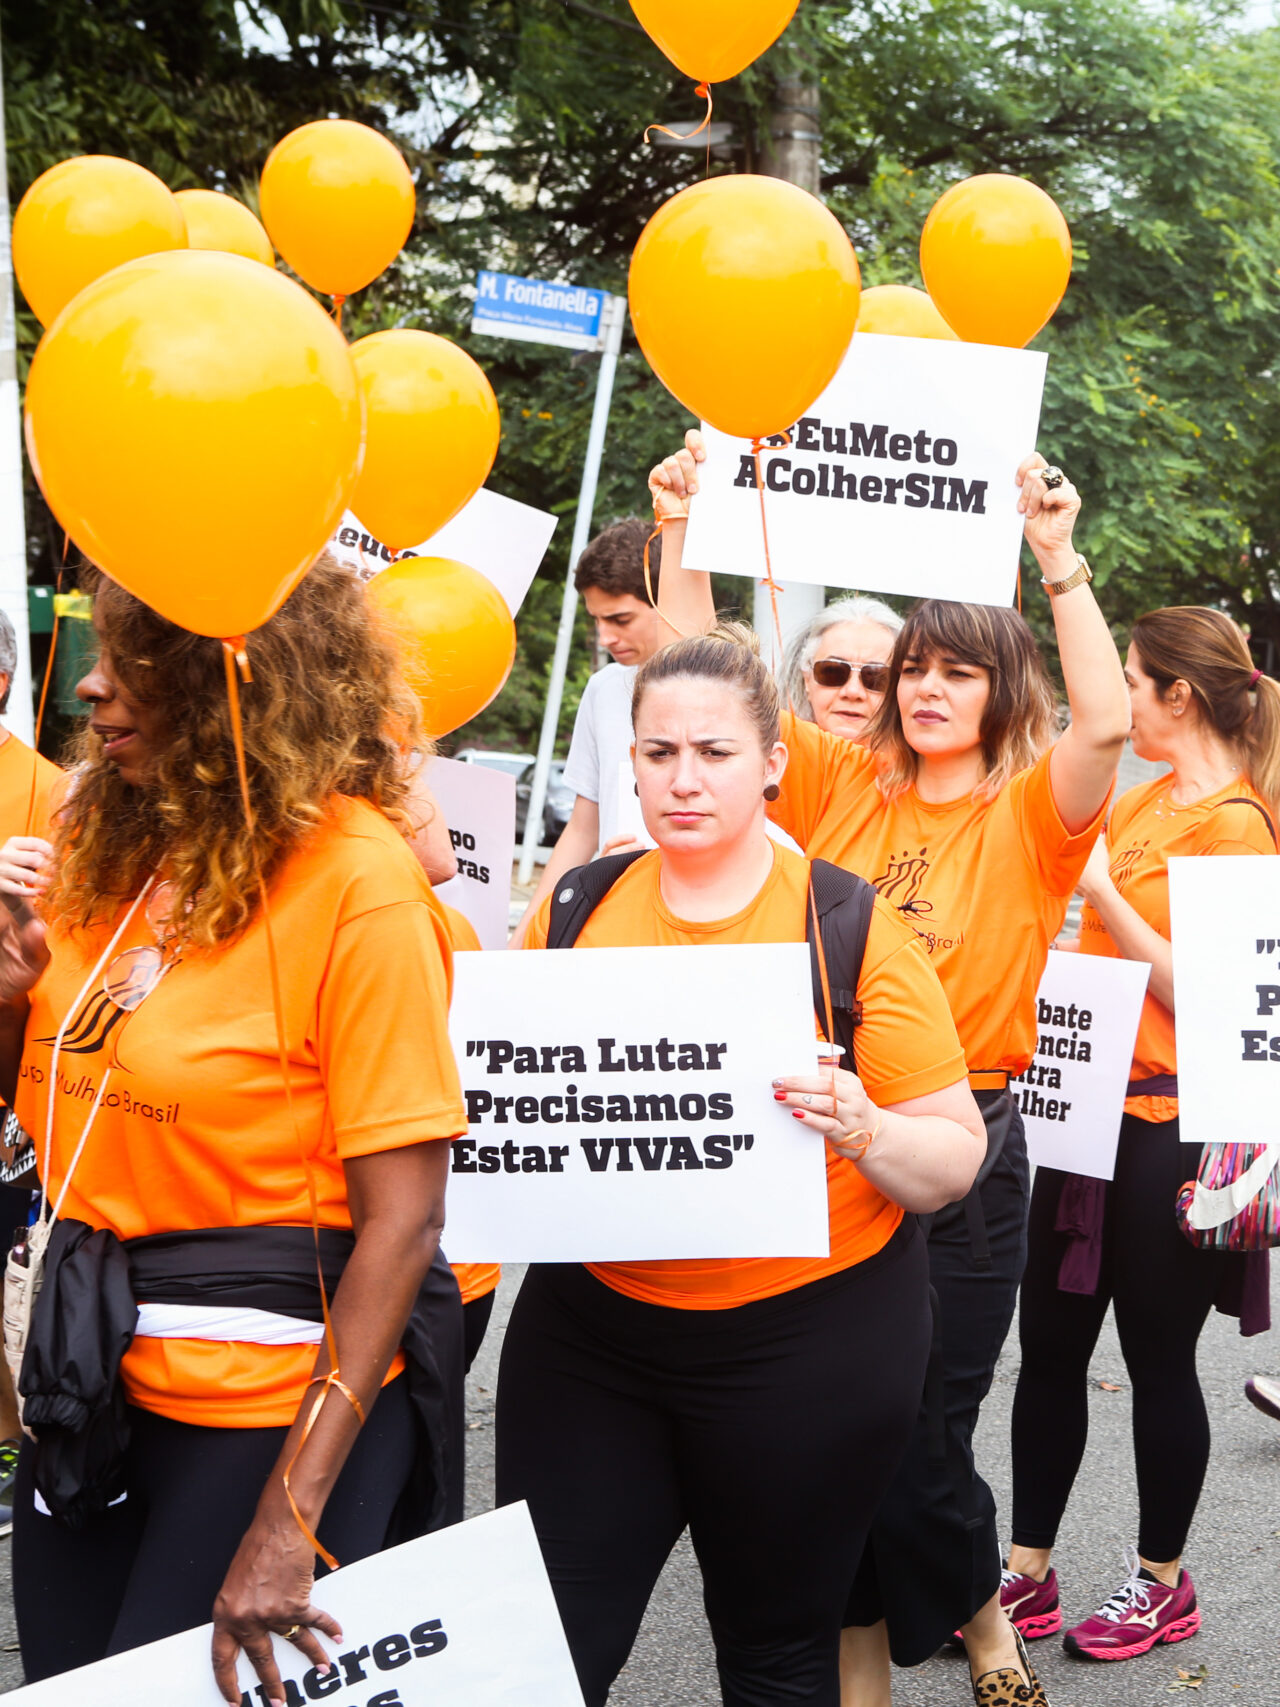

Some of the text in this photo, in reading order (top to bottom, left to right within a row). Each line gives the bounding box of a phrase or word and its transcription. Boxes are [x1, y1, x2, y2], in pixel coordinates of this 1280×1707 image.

[480, 274, 599, 316] M. Fontanella
[733, 454, 989, 515] AColherSIM
[456, 857, 490, 885] ras
[1035, 998, 1092, 1031] bate
[466, 1037, 728, 1074] "Para Lutar
[1035, 1031, 1092, 1063] ncia
[464, 1084, 734, 1124] Precisamos
[1012, 1089, 1072, 1122] lher
[450, 1134, 755, 1174] Estar VIVAS"
